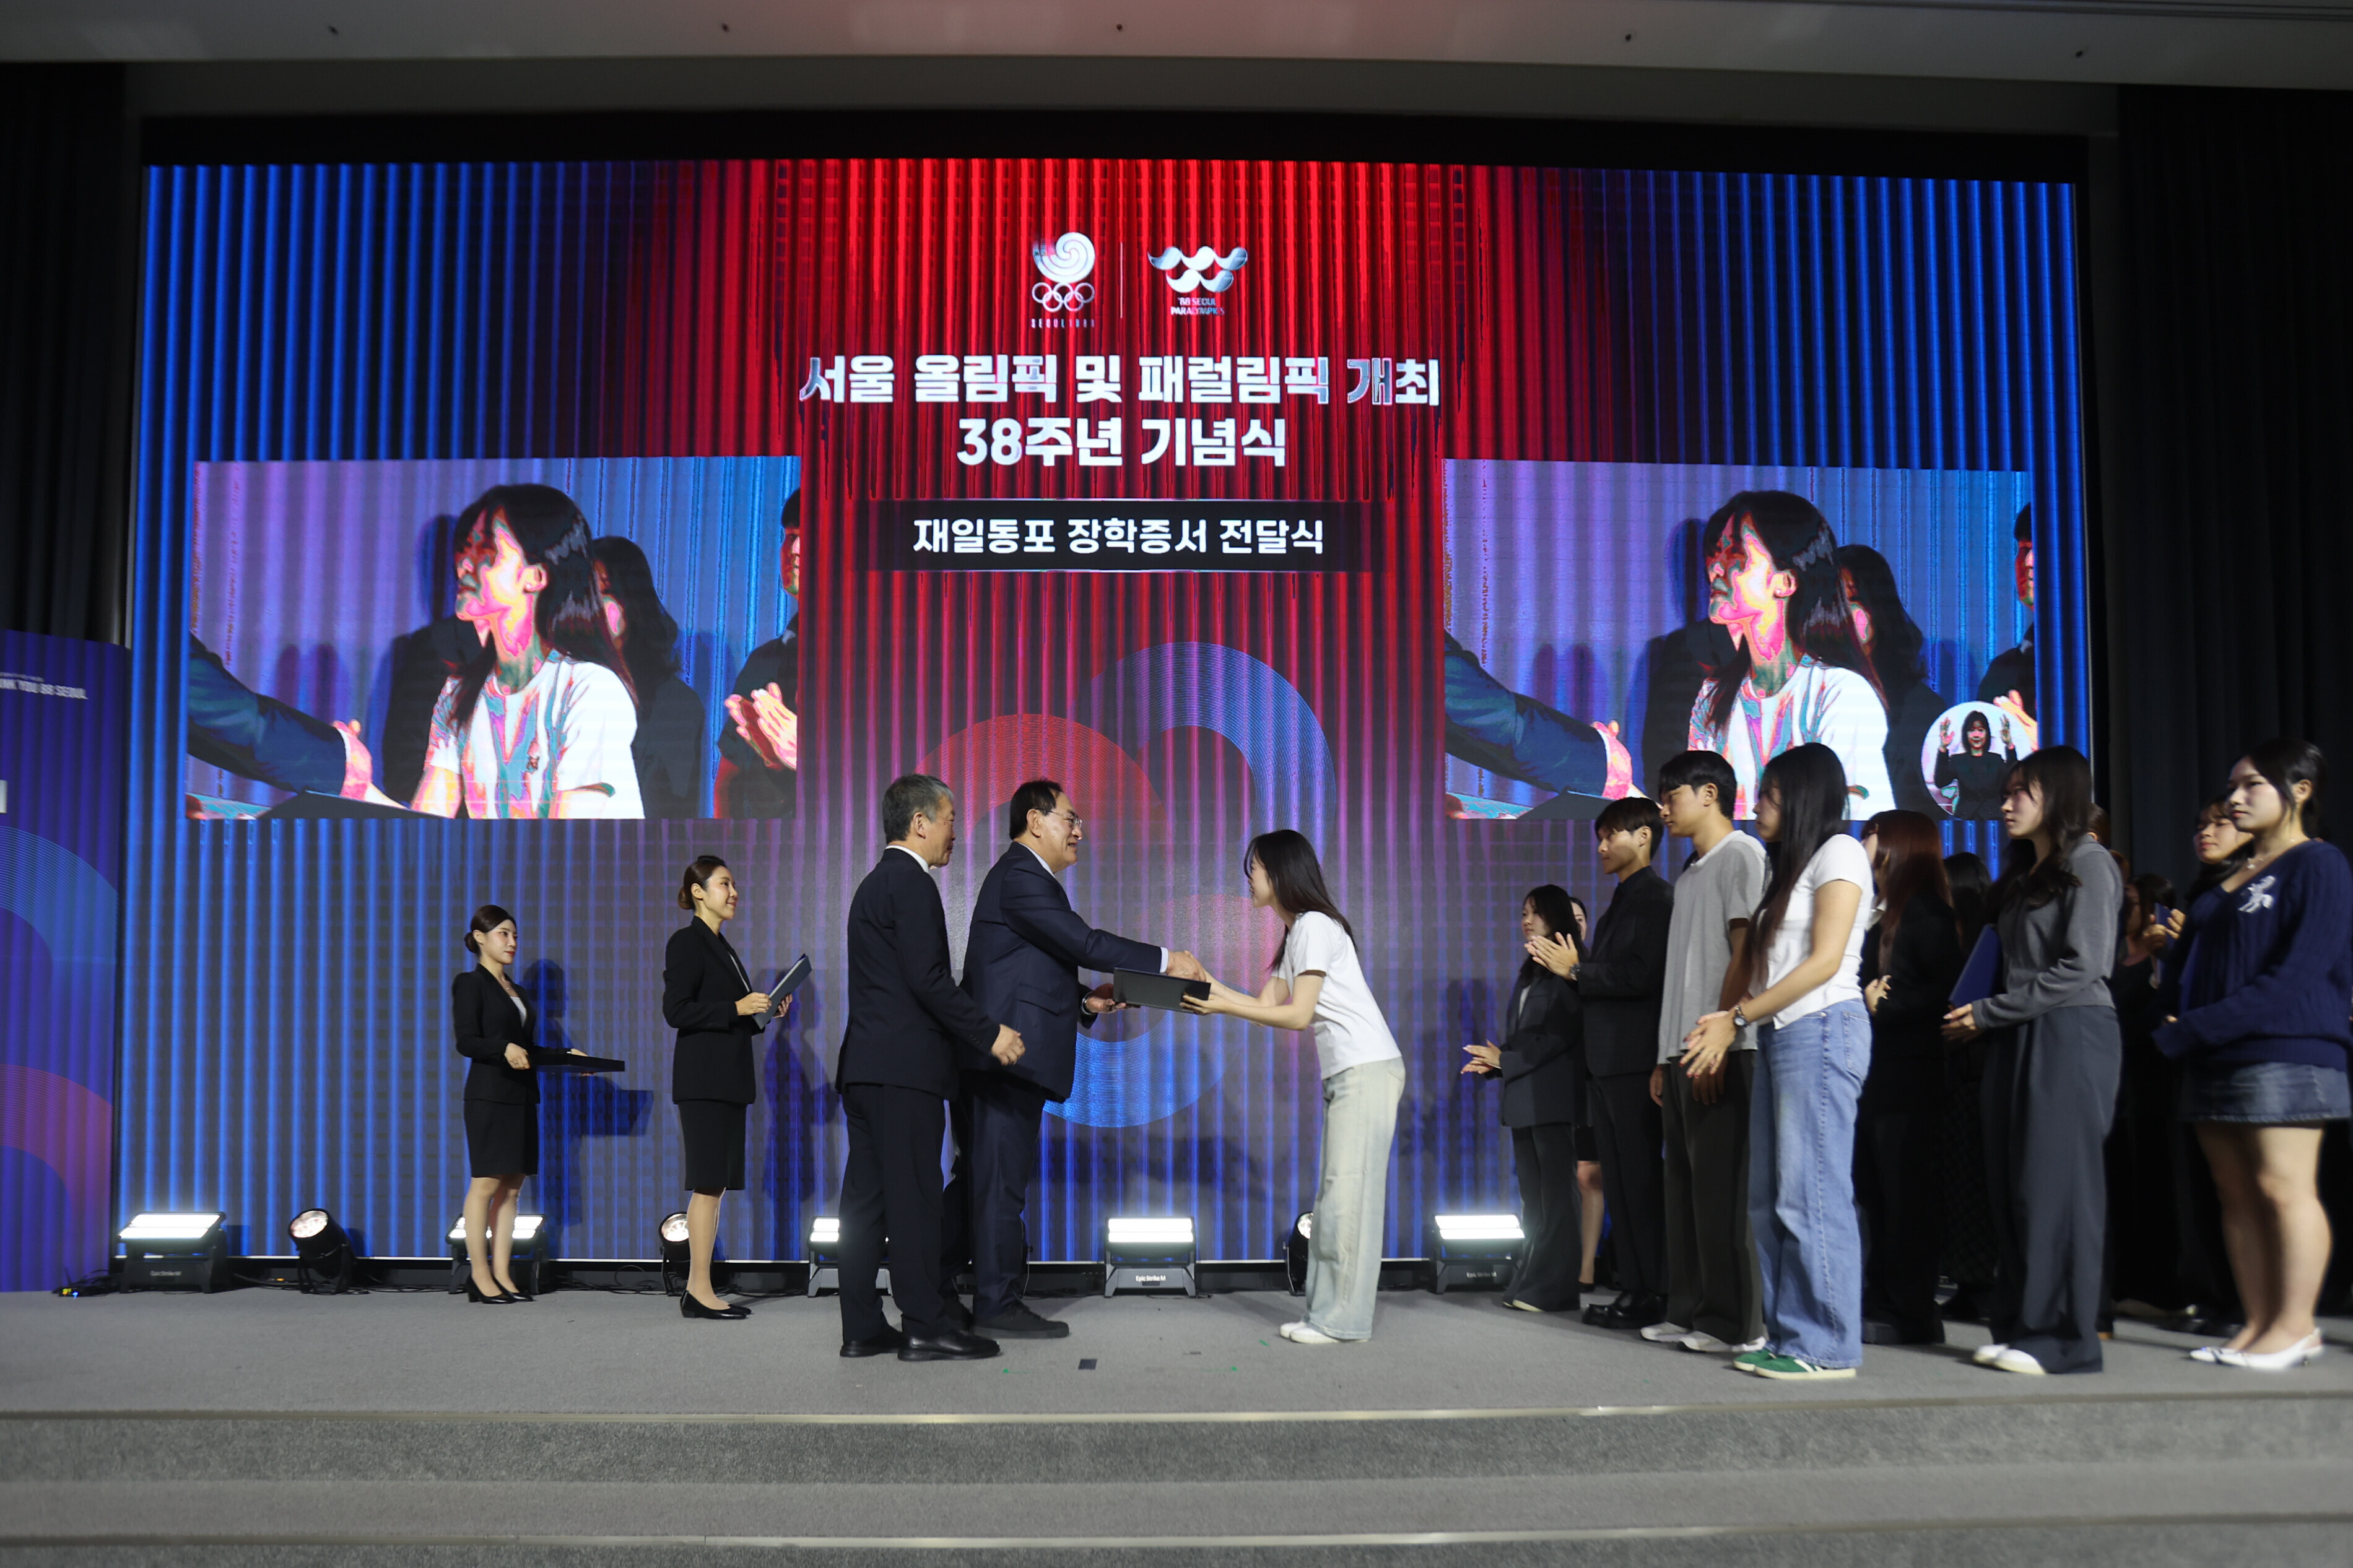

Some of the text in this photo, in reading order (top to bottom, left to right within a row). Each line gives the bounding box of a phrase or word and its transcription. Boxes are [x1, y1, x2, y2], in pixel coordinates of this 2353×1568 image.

[1191, 297, 1216, 306] SEOUL
[1031, 318, 1065, 329] SEOUL
[799, 355, 1440, 406] 서울 올림픽 및 패럴림픽 개최
[957, 417, 1286, 467] 38주년 기념식
[913, 518, 1323, 554] 재일동포 장학증서 전달식
[1135, 1275, 1146, 1283] Epic
